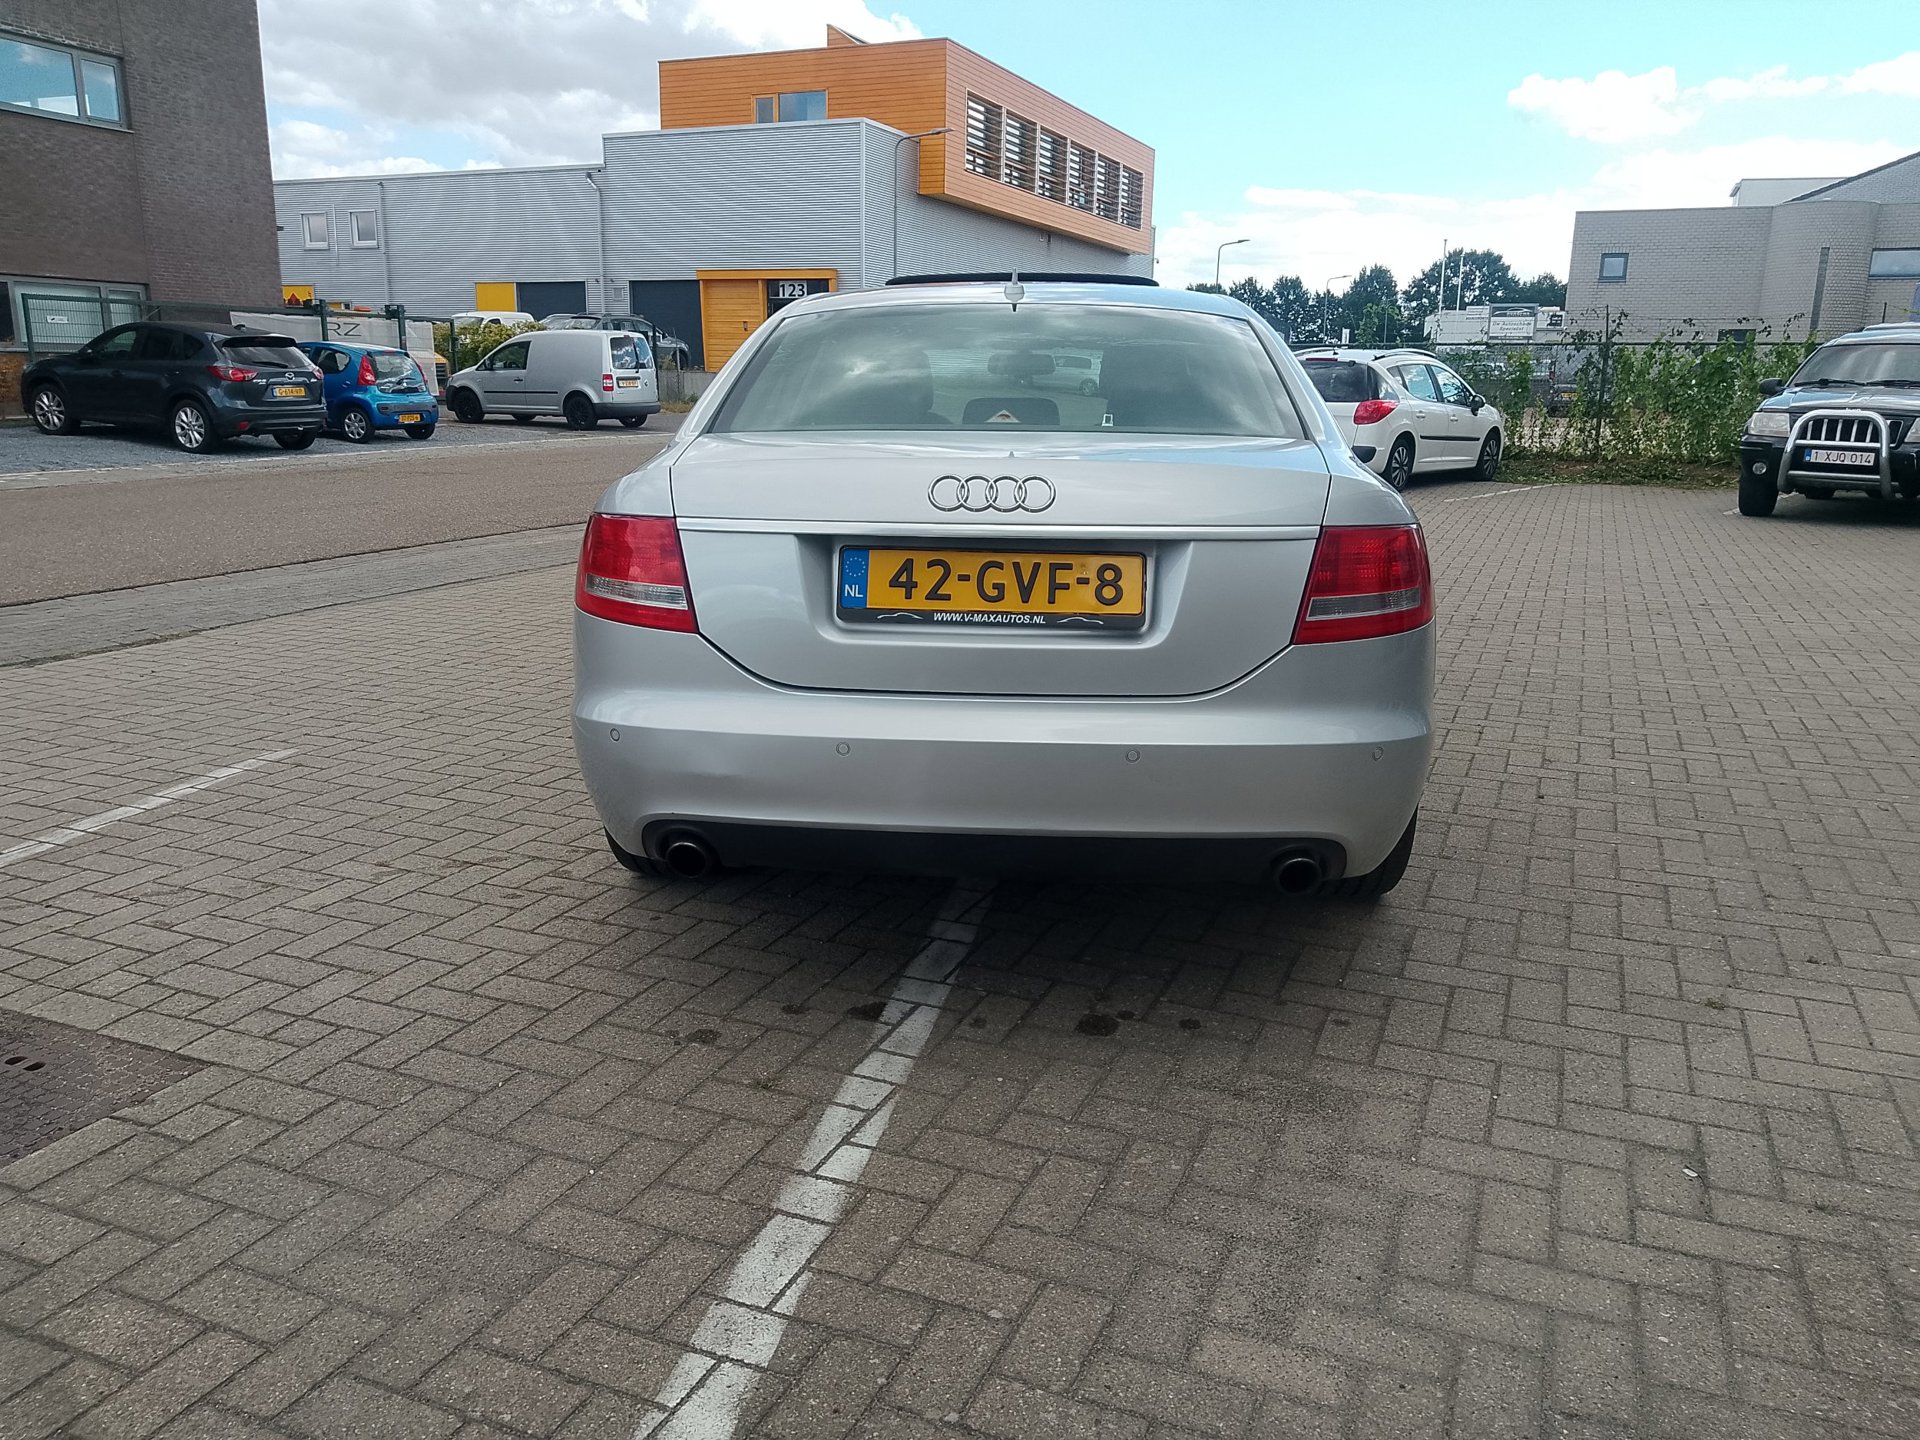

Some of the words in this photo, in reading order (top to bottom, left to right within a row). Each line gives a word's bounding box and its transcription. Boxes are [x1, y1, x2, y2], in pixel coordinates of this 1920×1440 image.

[779, 283, 805, 297] 123
[1814, 451, 1819, 461] 1
[1824, 451, 1846, 463] XJQ
[1850, 453, 1872, 464] 014
[888, 557, 1124, 606] 42-GVF-8
[844, 584, 864, 598] NL
[933, 612, 1047, 625] WWW.V-MAXAUTOS.NL
